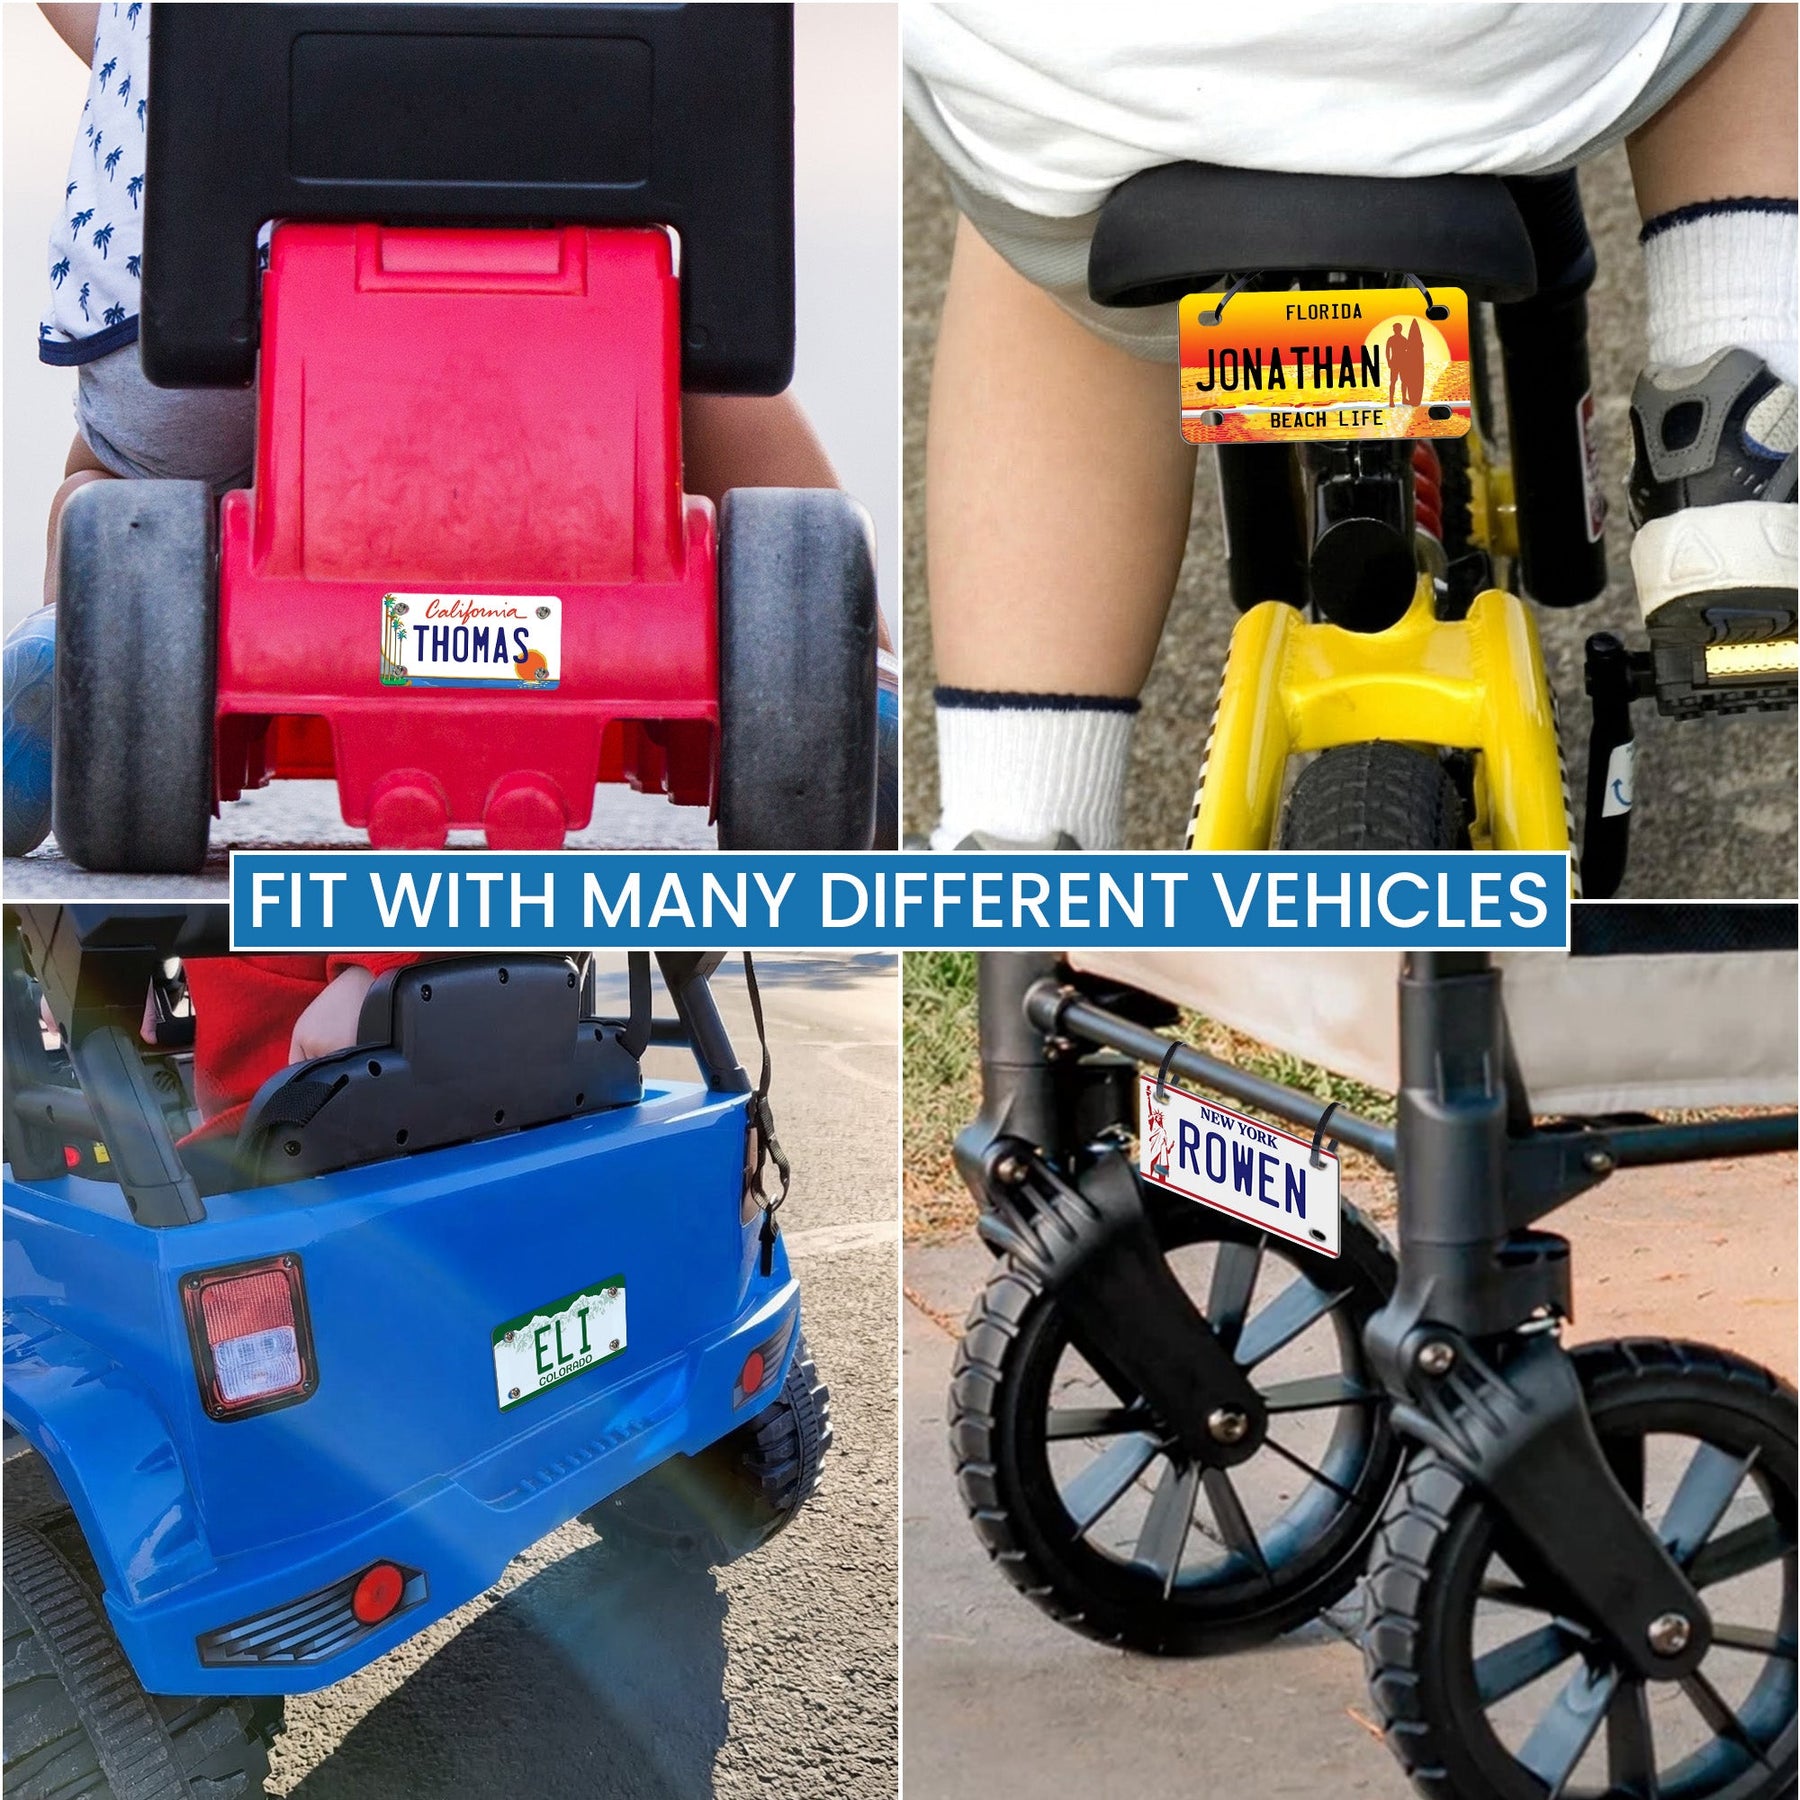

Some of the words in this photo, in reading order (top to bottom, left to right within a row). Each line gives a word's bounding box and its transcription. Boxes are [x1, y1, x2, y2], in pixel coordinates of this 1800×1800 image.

[1286, 303, 1363, 320] FLORIDA
[1196, 344, 1381, 392] JONATHAN
[1270, 411, 1327, 429] BEACH
[1339, 410, 1383, 426] LIFE
[425, 599, 528, 625] California
[413, 625, 529, 664] THOMAS
[1200, 1106, 1235, 1131] NEW
[1234, 1123, 1278, 1149] YORK
[1179, 1118, 1306, 1220] ROWEN
[534, 1306, 591, 1375] ELI
[538, 1354, 593, 1387] COLORADO
